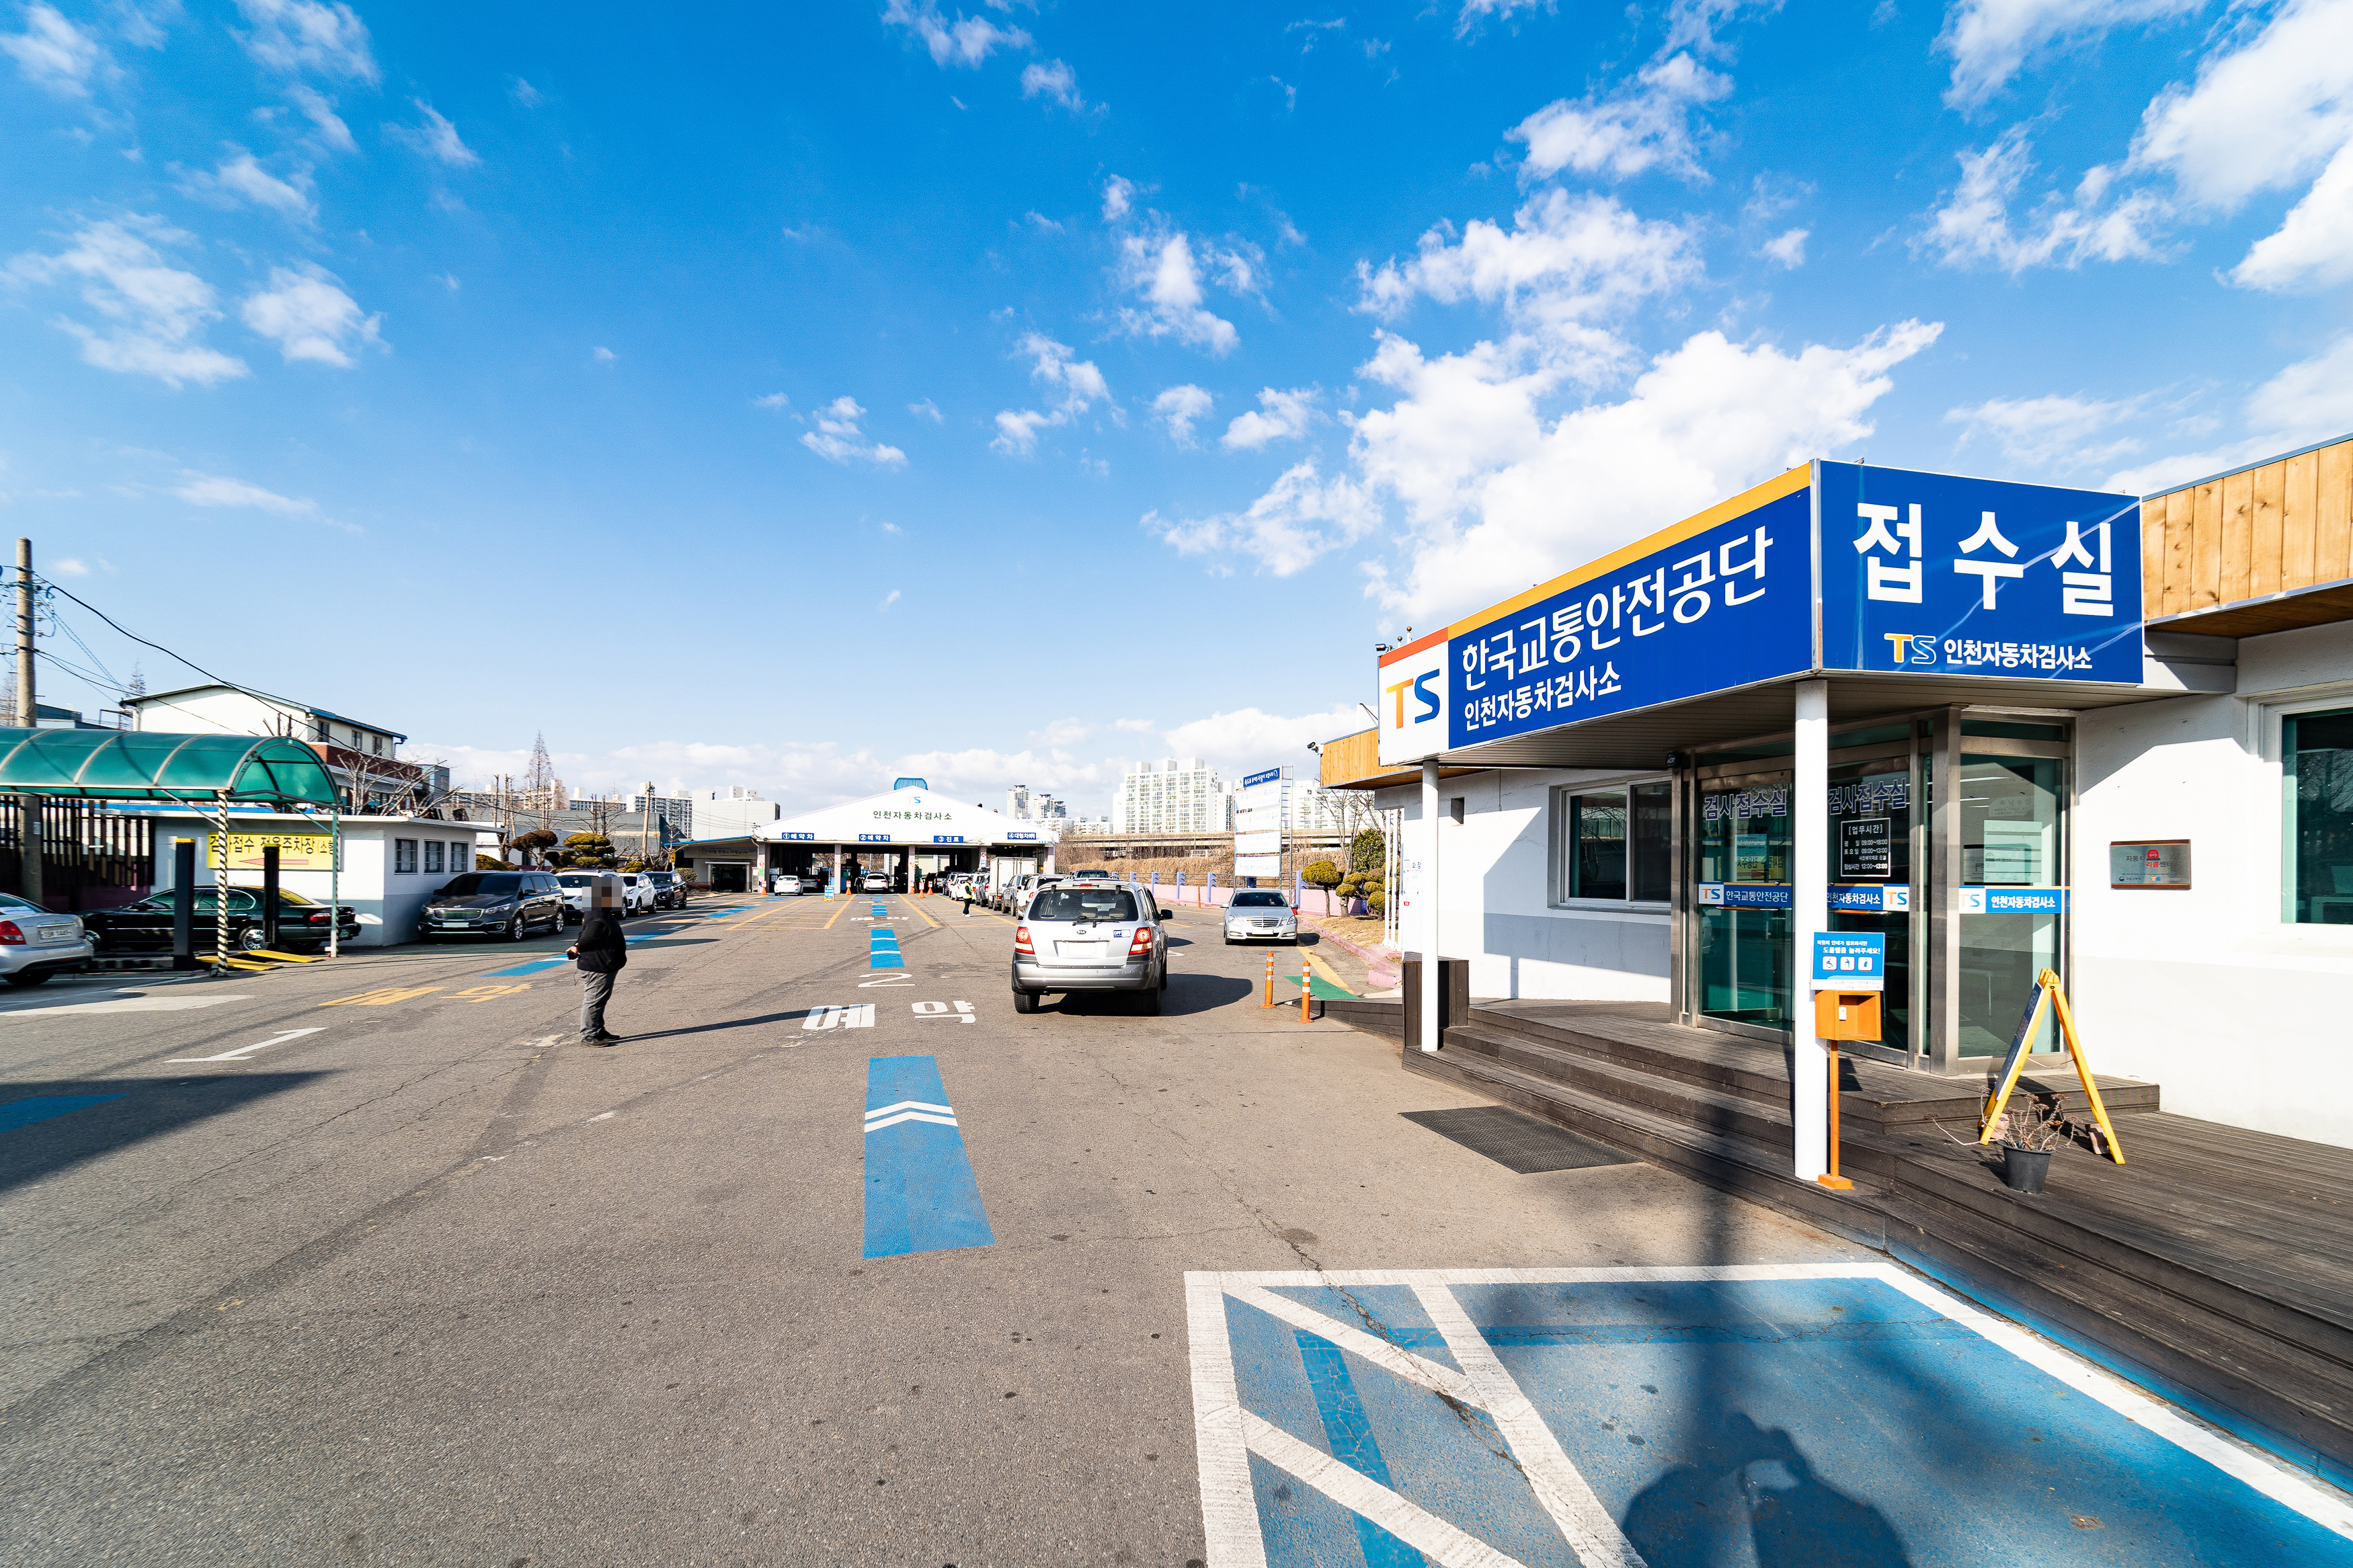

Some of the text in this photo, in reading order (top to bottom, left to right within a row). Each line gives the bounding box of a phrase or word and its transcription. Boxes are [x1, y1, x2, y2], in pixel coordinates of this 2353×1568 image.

[1853, 502, 2114, 617] 접수실
[1462, 525, 1773, 692] 한국교통안전공단
[1884, 632, 1937, 665] TS
[1944, 638, 2093, 670] 인천자동차검사소
[1386, 667, 1441, 729] TS
[1465, 661, 1622, 732] 인천자동차검사소
[1704, 789, 1787, 821] 검사접수실
[1828, 778, 1907, 815] 검사접수실
[873, 811, 952, 820] 인천자동차검사소
[210, 835, 254, 853] 검접수
[1701, 889, 1720, 899] TS
[1726, 891, 1788, 903] 한국교통안전공단
[1827, 892, 1881, 905] 인천자동차검사소
[1886, 892, 1907, 905] TS
[1959, 894, 1980, 907] TS
[1991, 896, 2056, 909] 인천자동차검사소
[858, 973, 916, 988] 2
